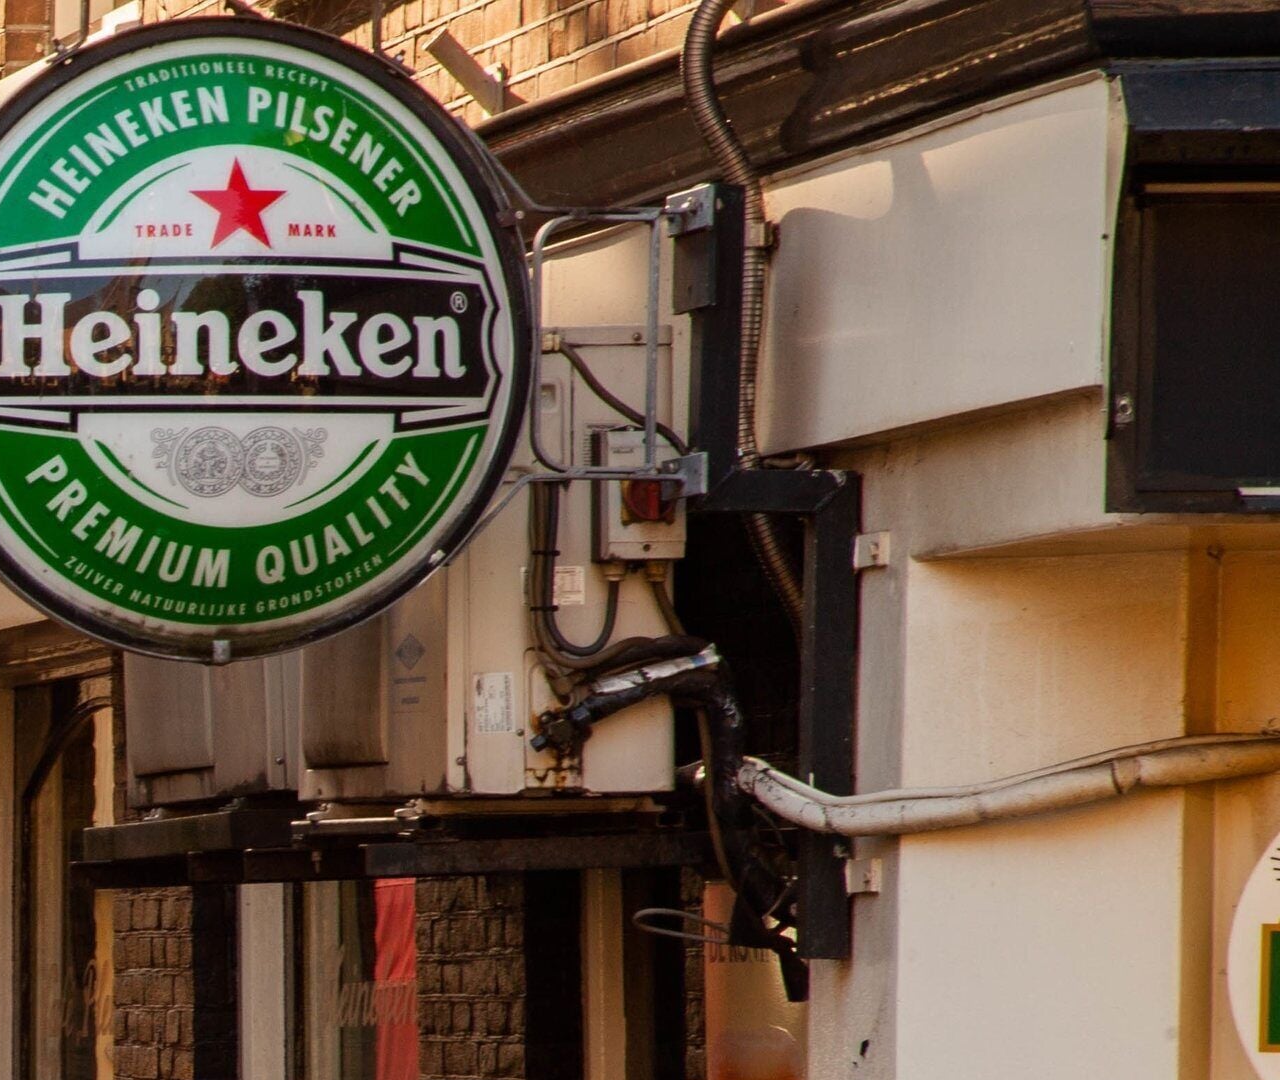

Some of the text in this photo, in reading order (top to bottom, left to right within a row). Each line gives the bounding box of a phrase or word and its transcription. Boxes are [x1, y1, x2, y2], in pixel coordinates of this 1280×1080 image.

[124, 61, 329, 92] TRADITIONEEL RECEPT
[28, 86, 422, 219] HEINEKEN PILSENER
[135, 223, 337, 238] TRADE MARK
[25, 451, 430, 588] PREMIUM QUALITY
[64, 554, 383, 616] ZUIVER NATUURLIJKE GRONDSTOFFEN
